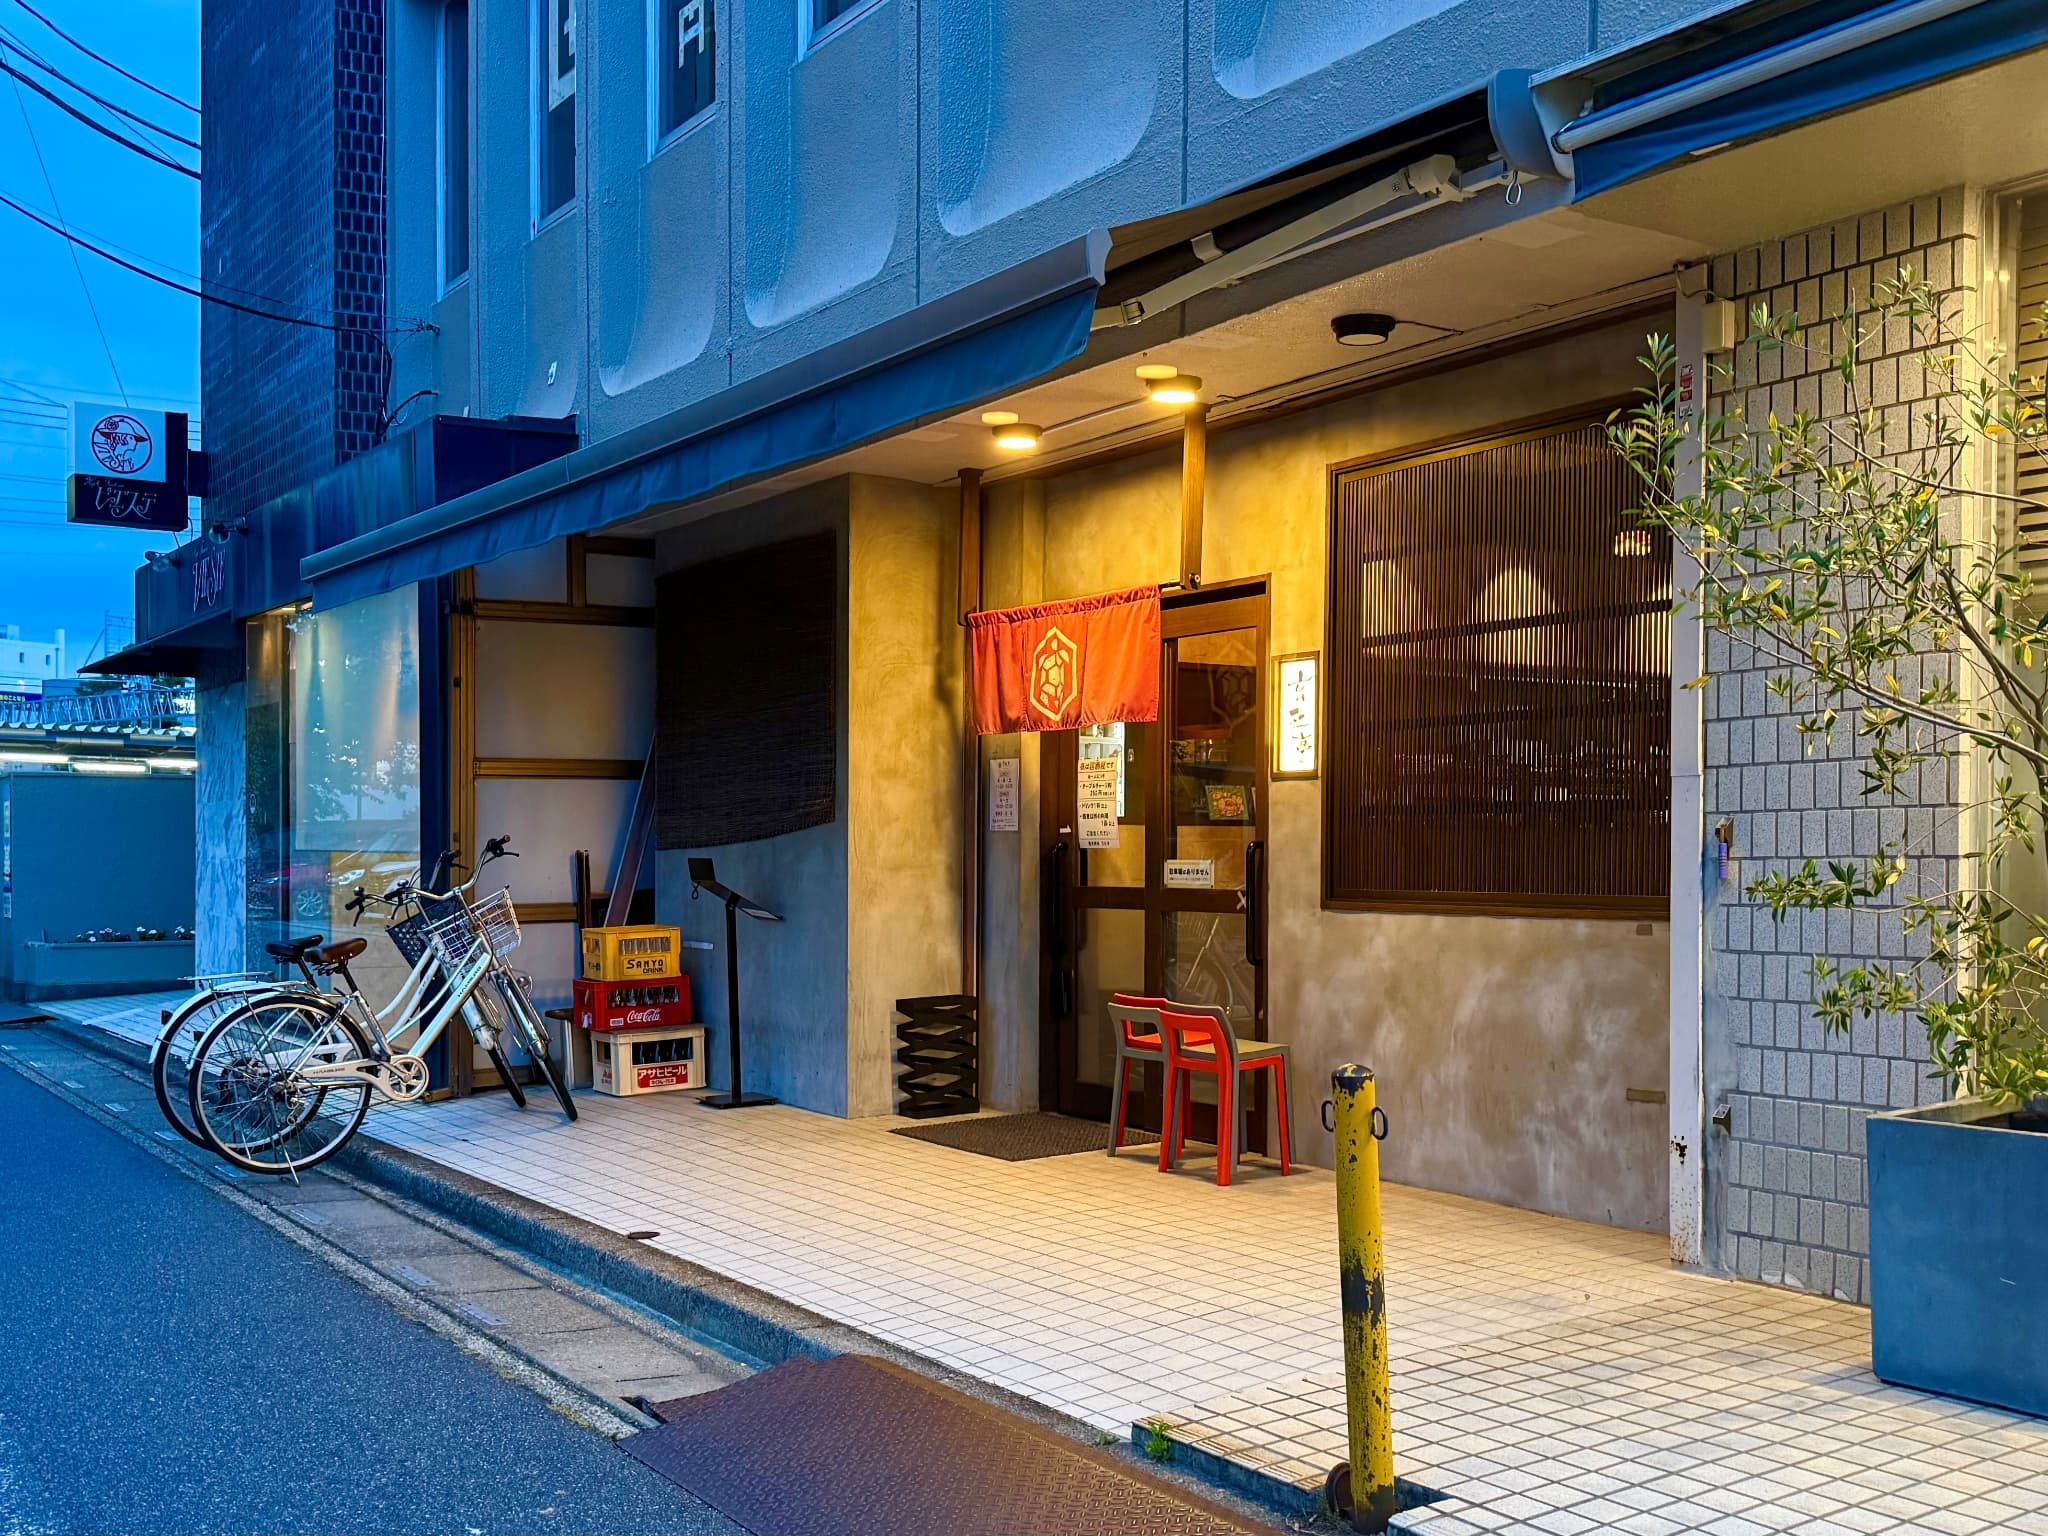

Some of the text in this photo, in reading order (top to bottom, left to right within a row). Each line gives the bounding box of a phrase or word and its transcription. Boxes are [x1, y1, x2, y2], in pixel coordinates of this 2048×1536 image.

[626, 959, 664, 969] SANYO
[638, 1065, 687, 1079] アサヒビール
